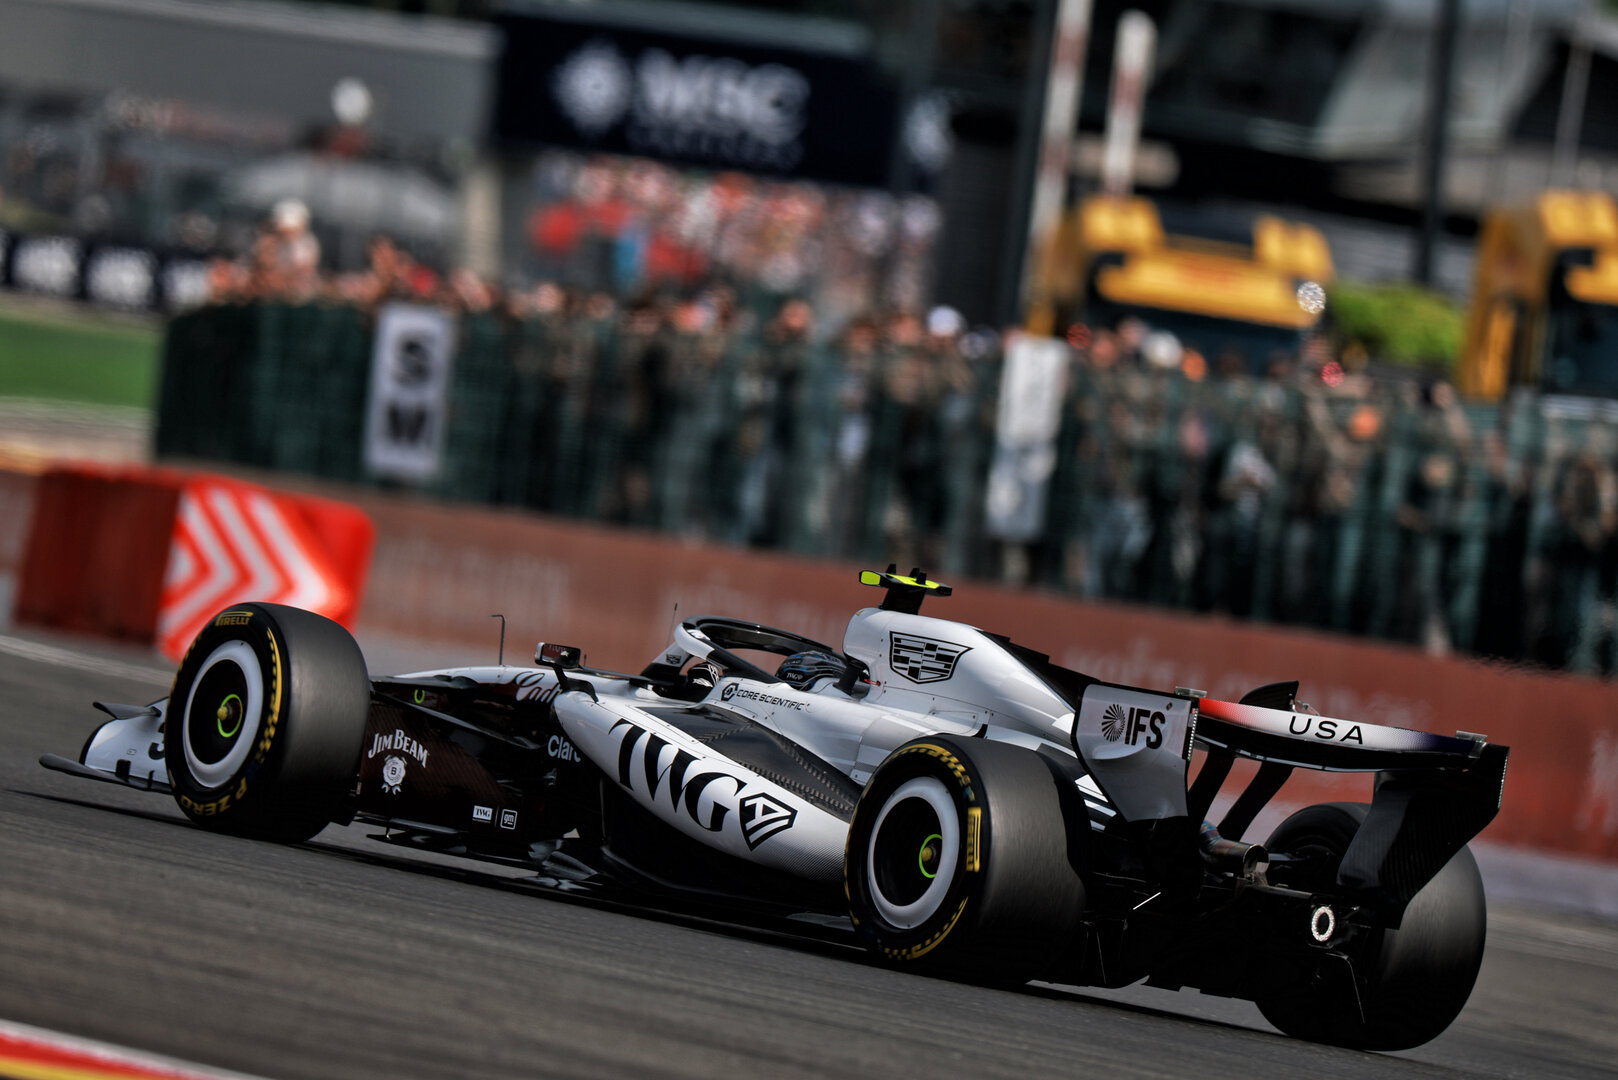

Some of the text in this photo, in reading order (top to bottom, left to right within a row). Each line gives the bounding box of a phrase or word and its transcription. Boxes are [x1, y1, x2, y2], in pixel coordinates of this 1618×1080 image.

[214, 611, 254, 626] PIRELLI
[736, 689, 805, 711] CORE SCIENTIFIC
[1125, 707, 1166, 750] IFS
[1289, 715, 1364, 745] USA
[368, 729, 428, 768] JIM BEAM
[608, 718, 748, 833] TWG
[180, 794, 231, 817] ZERO
